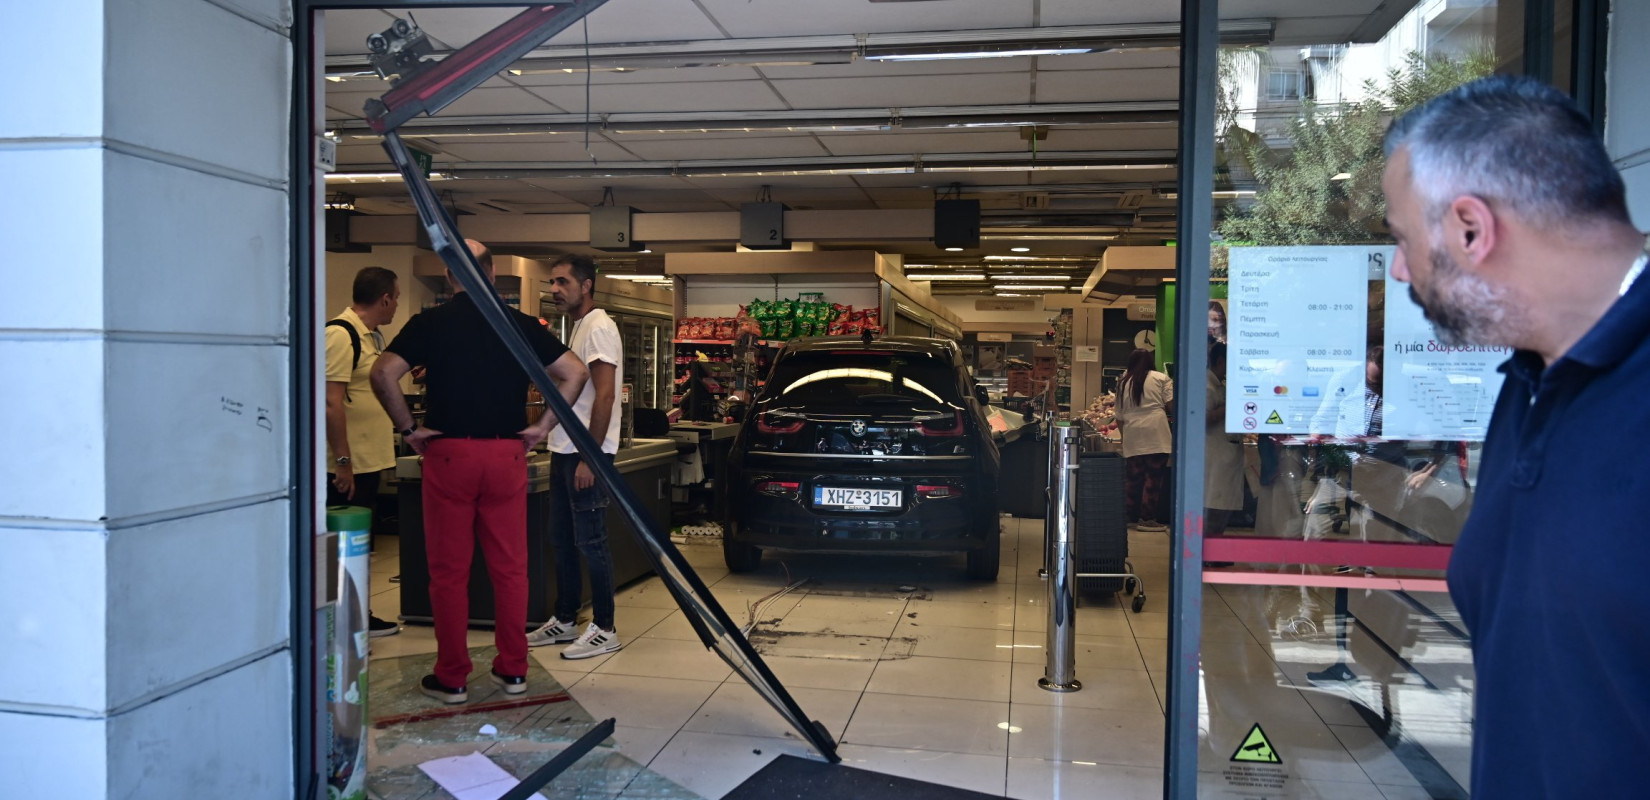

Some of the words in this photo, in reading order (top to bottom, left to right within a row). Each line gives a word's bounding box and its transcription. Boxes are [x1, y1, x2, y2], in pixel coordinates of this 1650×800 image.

[617, 232, 625, 242] 3
[769, 230, 778, 240] 2
[1240, 300, 1269, 308] Τετάρτη
[1240, 315, 1266, 323] Πέμπτη
[1240, 330, 1280, 338] Παρασκευή
[1395, 341, 1402, 354] ή
[1405, 341, 1424, 354] μία
